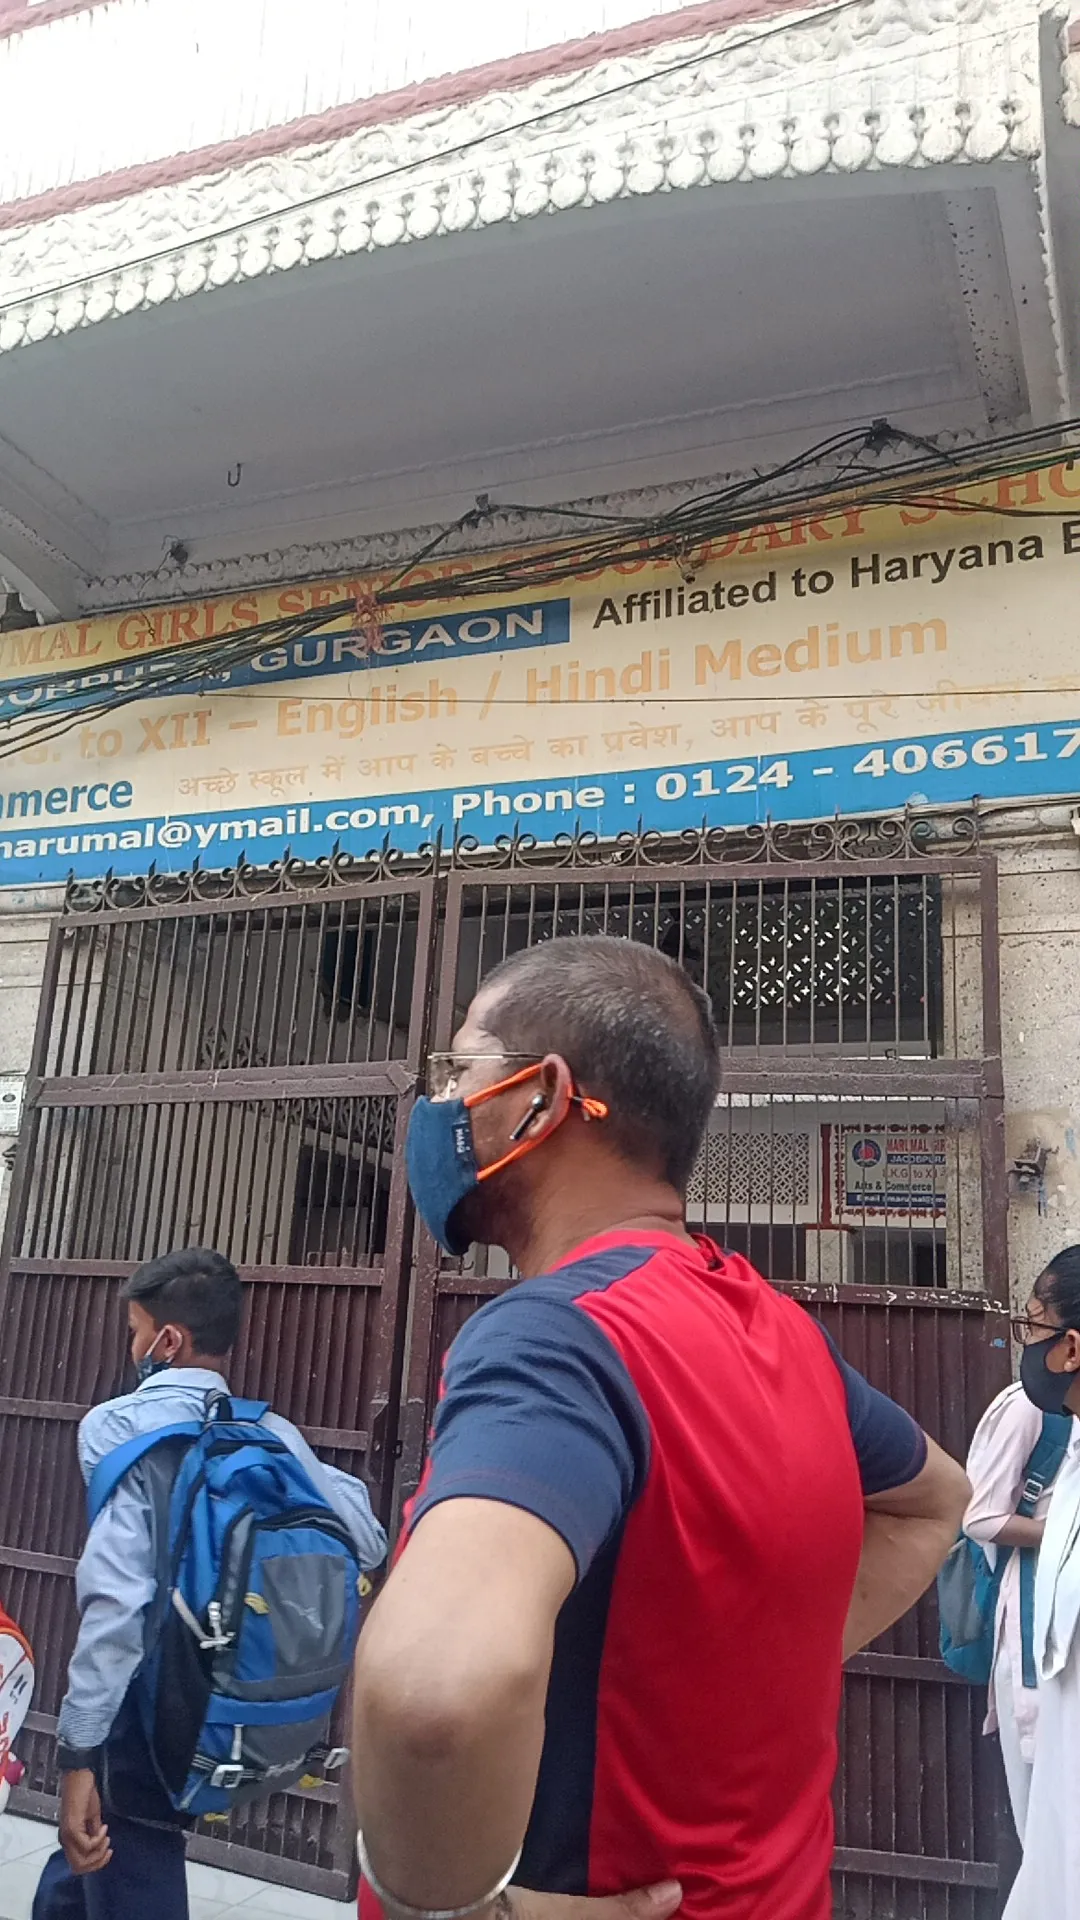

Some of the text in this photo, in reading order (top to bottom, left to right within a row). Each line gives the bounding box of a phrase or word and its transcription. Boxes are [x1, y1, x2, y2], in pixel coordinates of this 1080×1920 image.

[592, 570, 777, 629] Affiliated
[791, 567, 834, 598] to
[850, 534, 1044, 588] Haryana
[0, 622, 102, 668] MAL
[116, 594, 259, 650] GIRLS
[250, 609, 543, 674] GURGAON
[78, 723, 123, 759] to
[136, 708, 213, 753] XII
[277, 678, 458, 740] English
[526, 648, 671, 708] Hindi
[694, 616, 948, 687] Medium
[178, 767, 240, 798] अच्छे
[248, 765, 309, 797] स्कूल
[321, 756, 348, 782] में
[357, 754, 418, 778] आप
[429, 742, 458, 771] के
[469, 735, 535, 768] बच्चे
[547, 733, 589, 759] का
[710, 710, 783, 740] आप
[795, 700, 831, 729] के
[0, 779, 134, 819] merce
[452, 785, 606, 820] Phone
[623, 783, 637, 805] :
[655, 760, 794, 801] 0124
